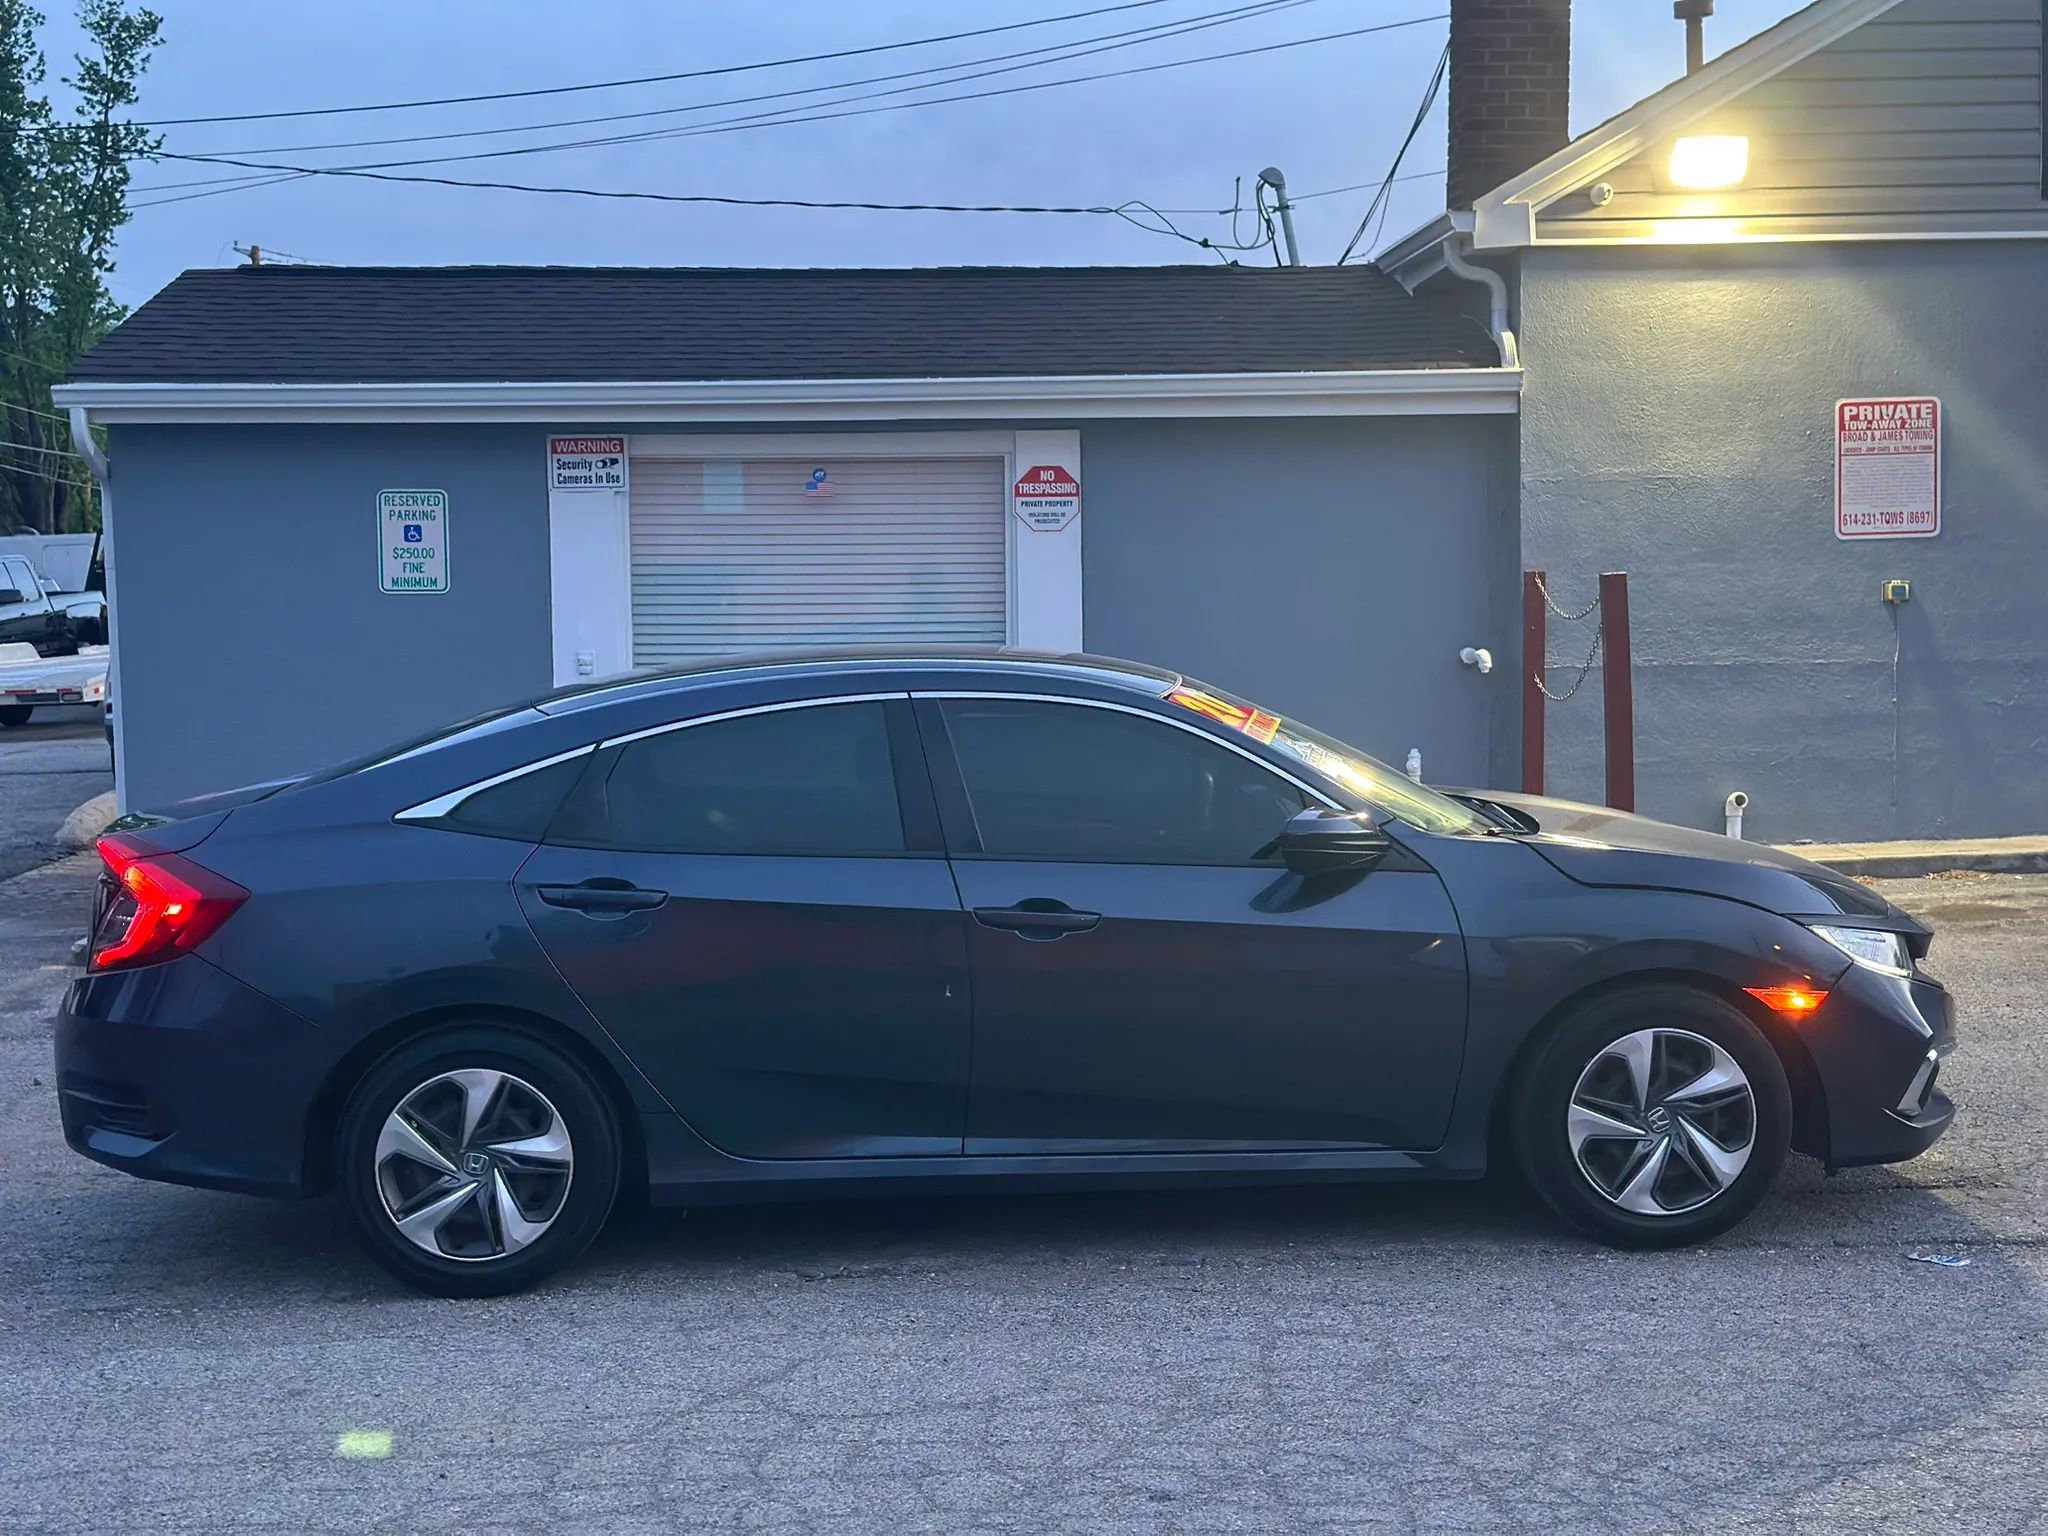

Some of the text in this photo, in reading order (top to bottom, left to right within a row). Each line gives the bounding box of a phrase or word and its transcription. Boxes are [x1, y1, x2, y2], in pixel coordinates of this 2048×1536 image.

[1844, 404, 1932, 420] PRIVATE
[1844, 418, 1933, 431] TOW-AWAY ZONE
[1843, 429, 1934, 442] BROAD & JAMES TOWING
[556, 440, 620, 452] WARNING
[556, 458, 593, 472] Security
[557, 471, 621, 484] Cameras In Use
[1040, 470, 1055, 481] NO
[1018, 483, 1076, 494] TRESPASSING
[384, 495, 440, 506] RESERVED
[1020, 500, 1073, 508] PRIVATE PROPERTY
[389, 510, 436, 520] PARKING
[1906, 510, 1934, 525] (8697)
[392, 547, 435, 559] $250.00
[402, 562, 425, 573] FINE
[391, 577, 438, 588] MINIMUM
